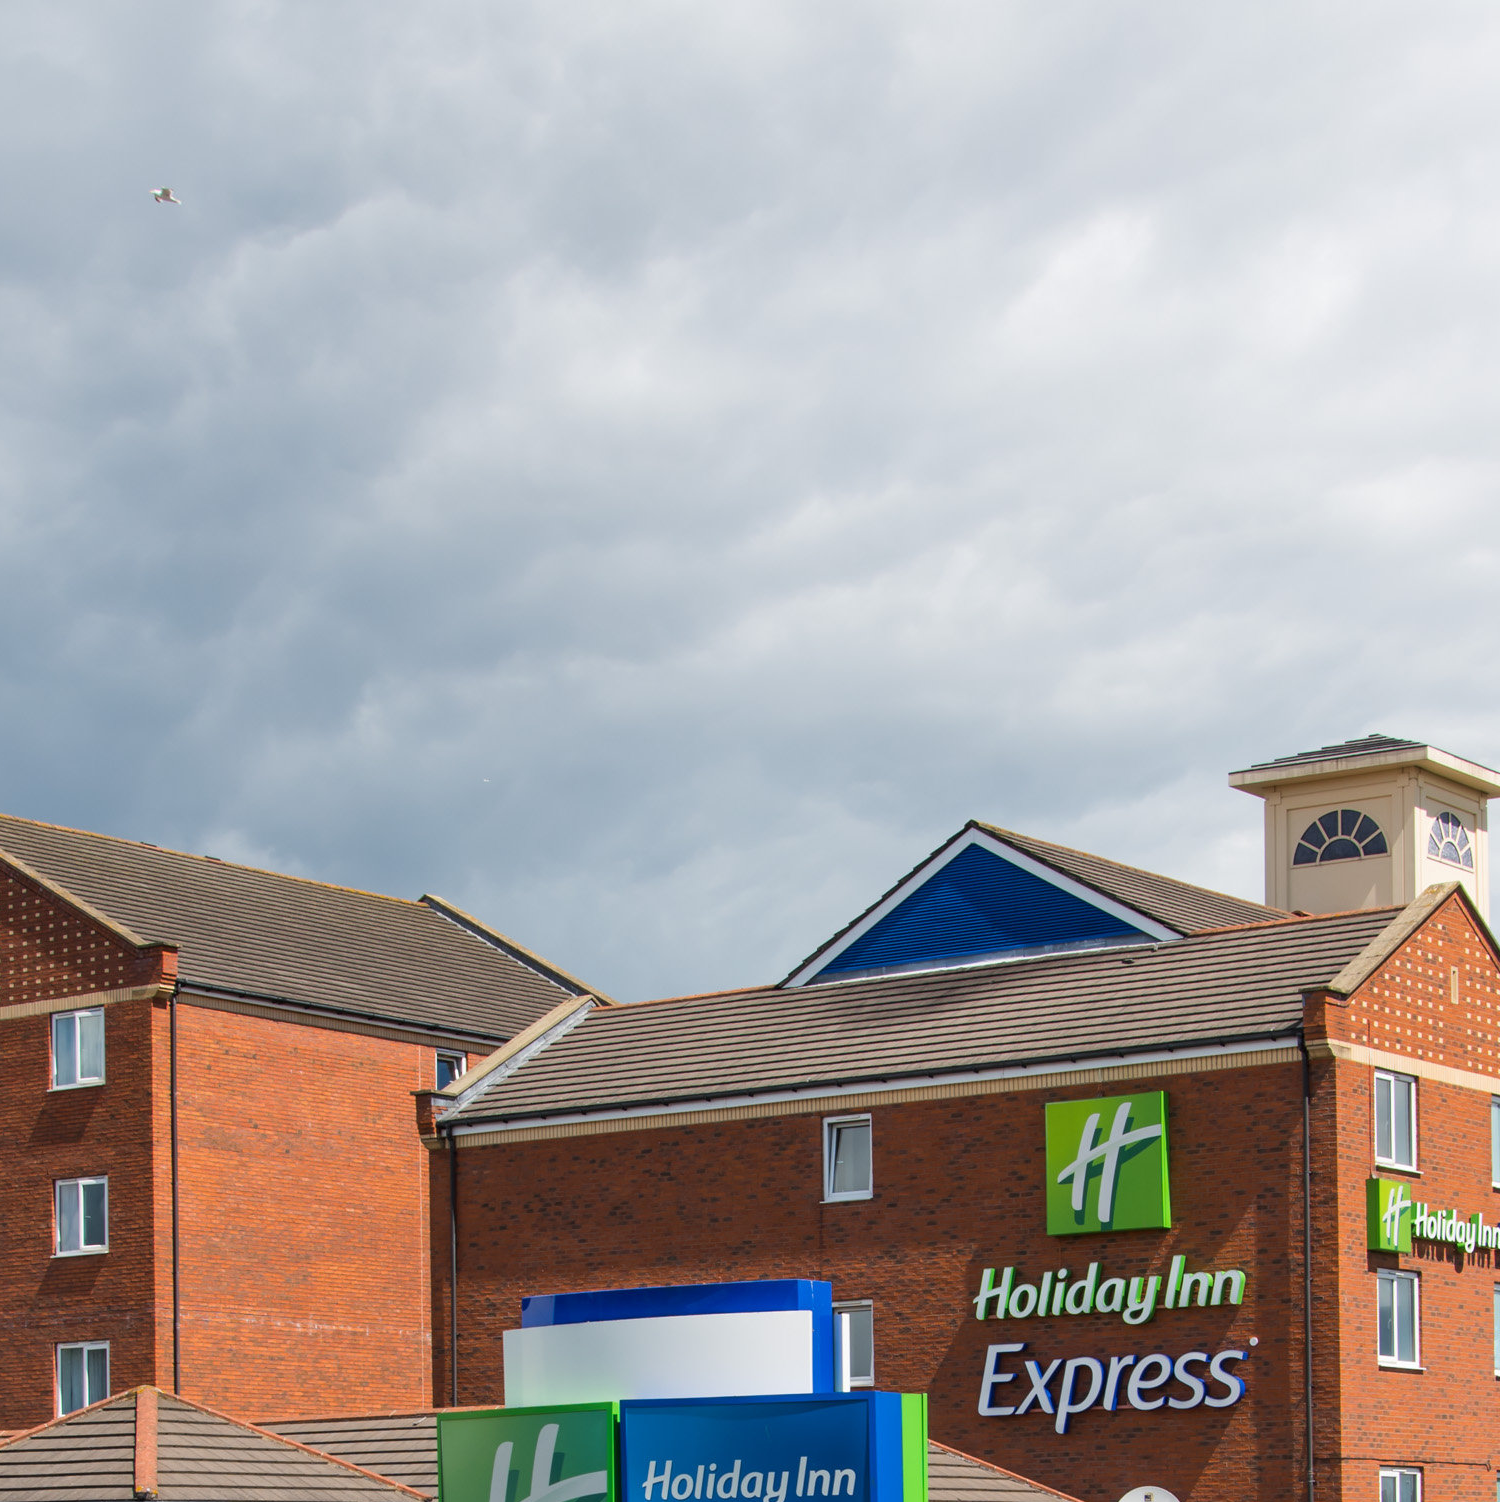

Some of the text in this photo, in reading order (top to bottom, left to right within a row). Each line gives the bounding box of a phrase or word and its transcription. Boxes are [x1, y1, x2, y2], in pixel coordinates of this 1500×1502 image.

[1413, 1202, 1476, 1254] Holiday
[1475, 1212, 1500, 1249] Inn
[973, 1254, 1246, 1325] Holiday Inn
[978, 1343, 1249, 1435] Express
[796, 1456, 857, 1498] Inn
